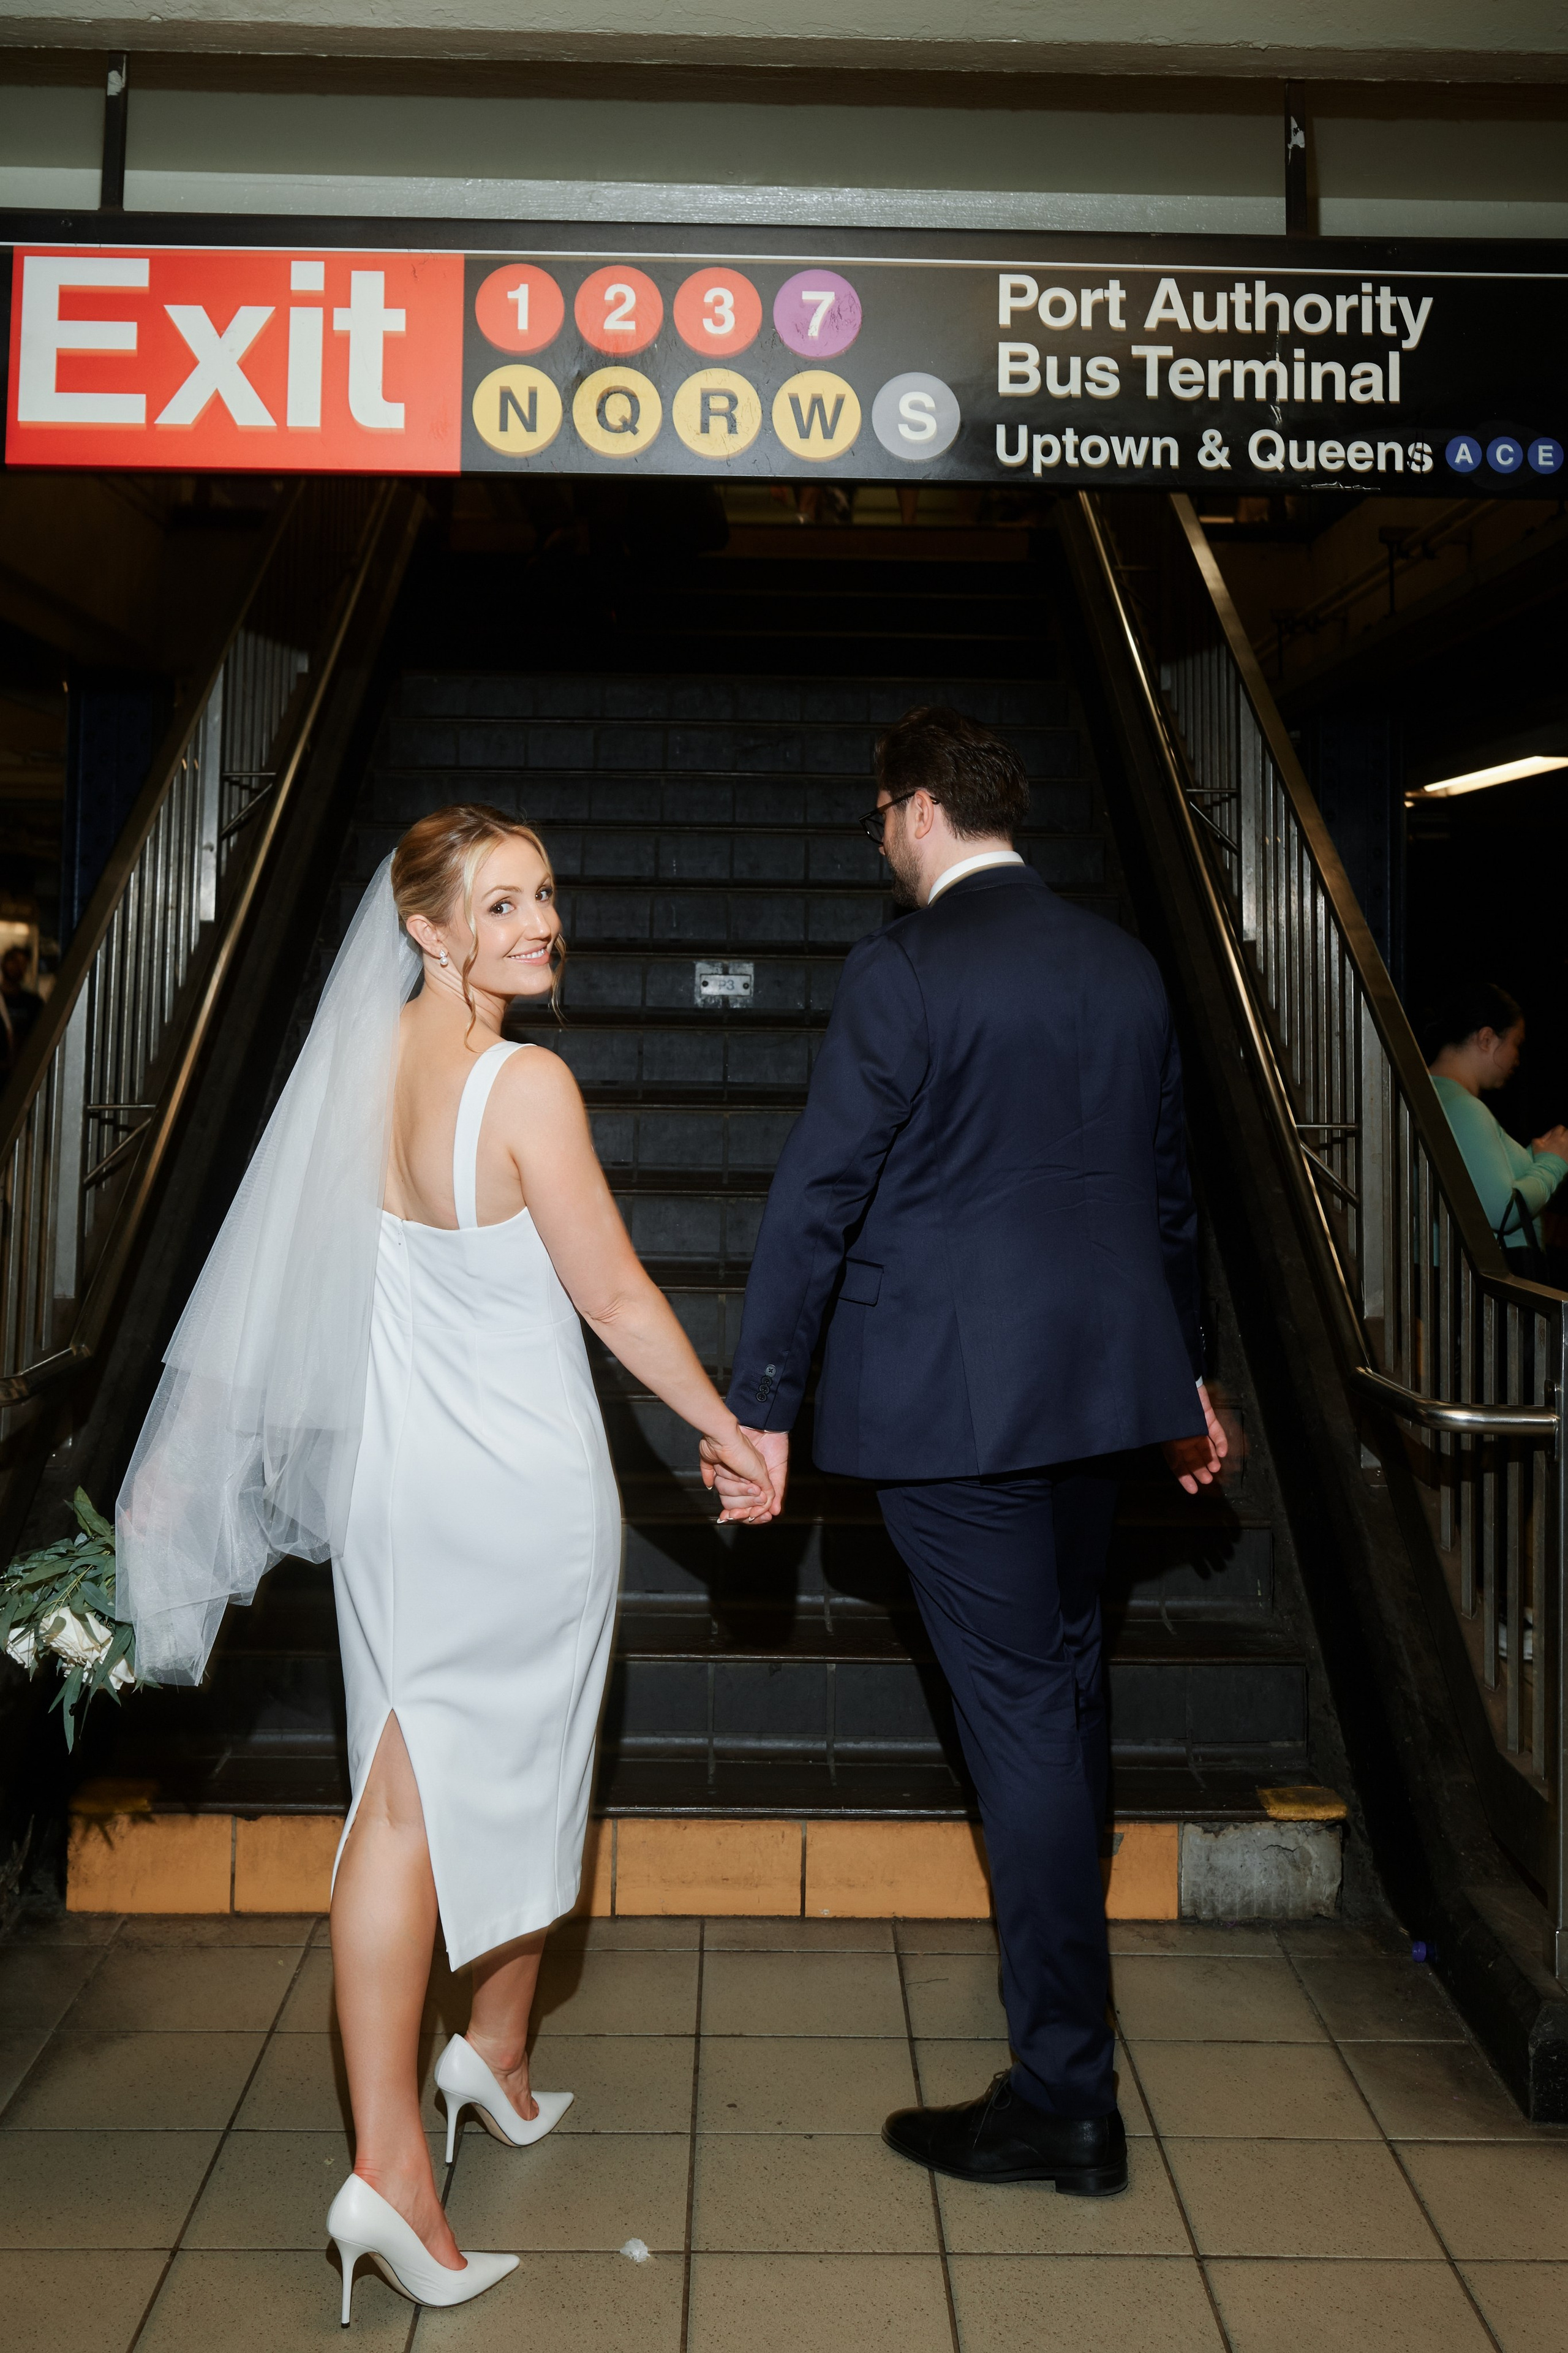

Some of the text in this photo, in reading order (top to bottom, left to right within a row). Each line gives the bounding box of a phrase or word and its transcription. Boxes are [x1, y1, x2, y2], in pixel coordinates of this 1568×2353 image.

[507, 283, 835, 336] 1 2 3 7
[998, 274, 1434, 350] Port Authority
[18, 256, 406, 428] Exit
[998, 342, 1401, 404] Bus Terminal
[499, 385, 937, 440] N Q R W S
[995, 424, 1553, 476] Uptown & Queens A C E
